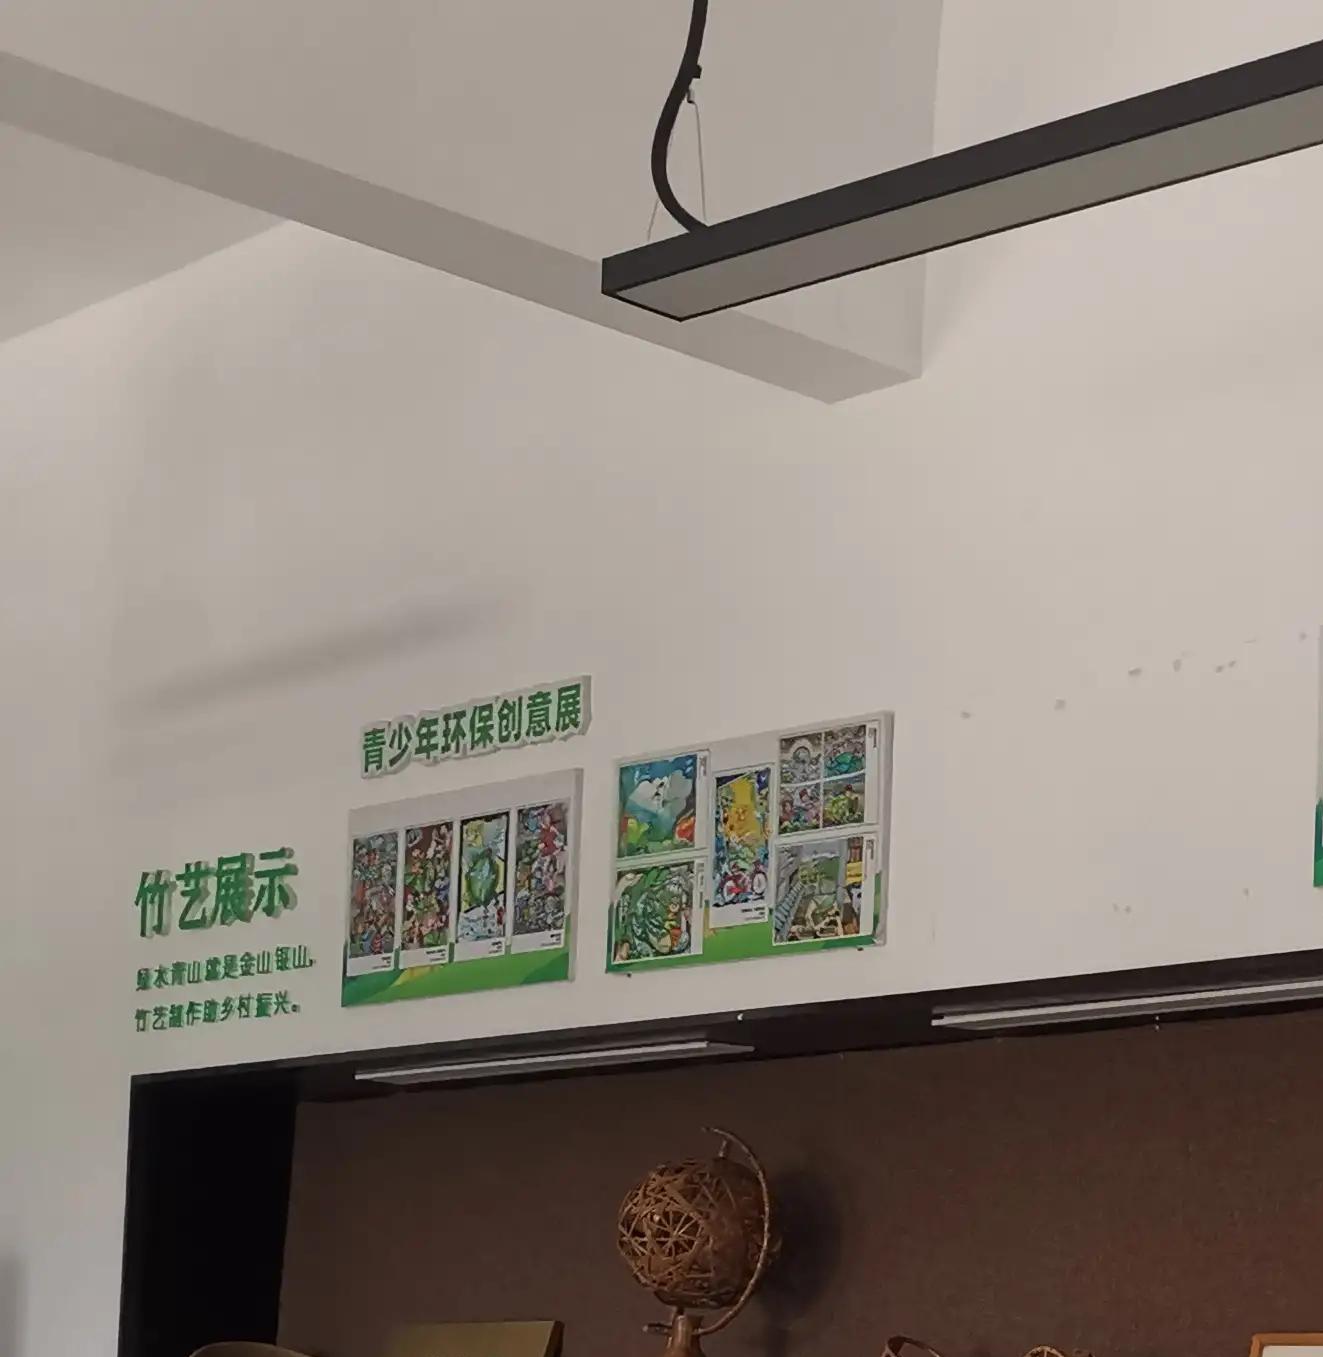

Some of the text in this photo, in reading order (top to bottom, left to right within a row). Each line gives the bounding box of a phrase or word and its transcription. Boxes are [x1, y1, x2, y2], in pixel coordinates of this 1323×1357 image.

[361, 683, 582, 774] 青少年环保创意展
[134, 846, 299, 938] 竹艺展示
